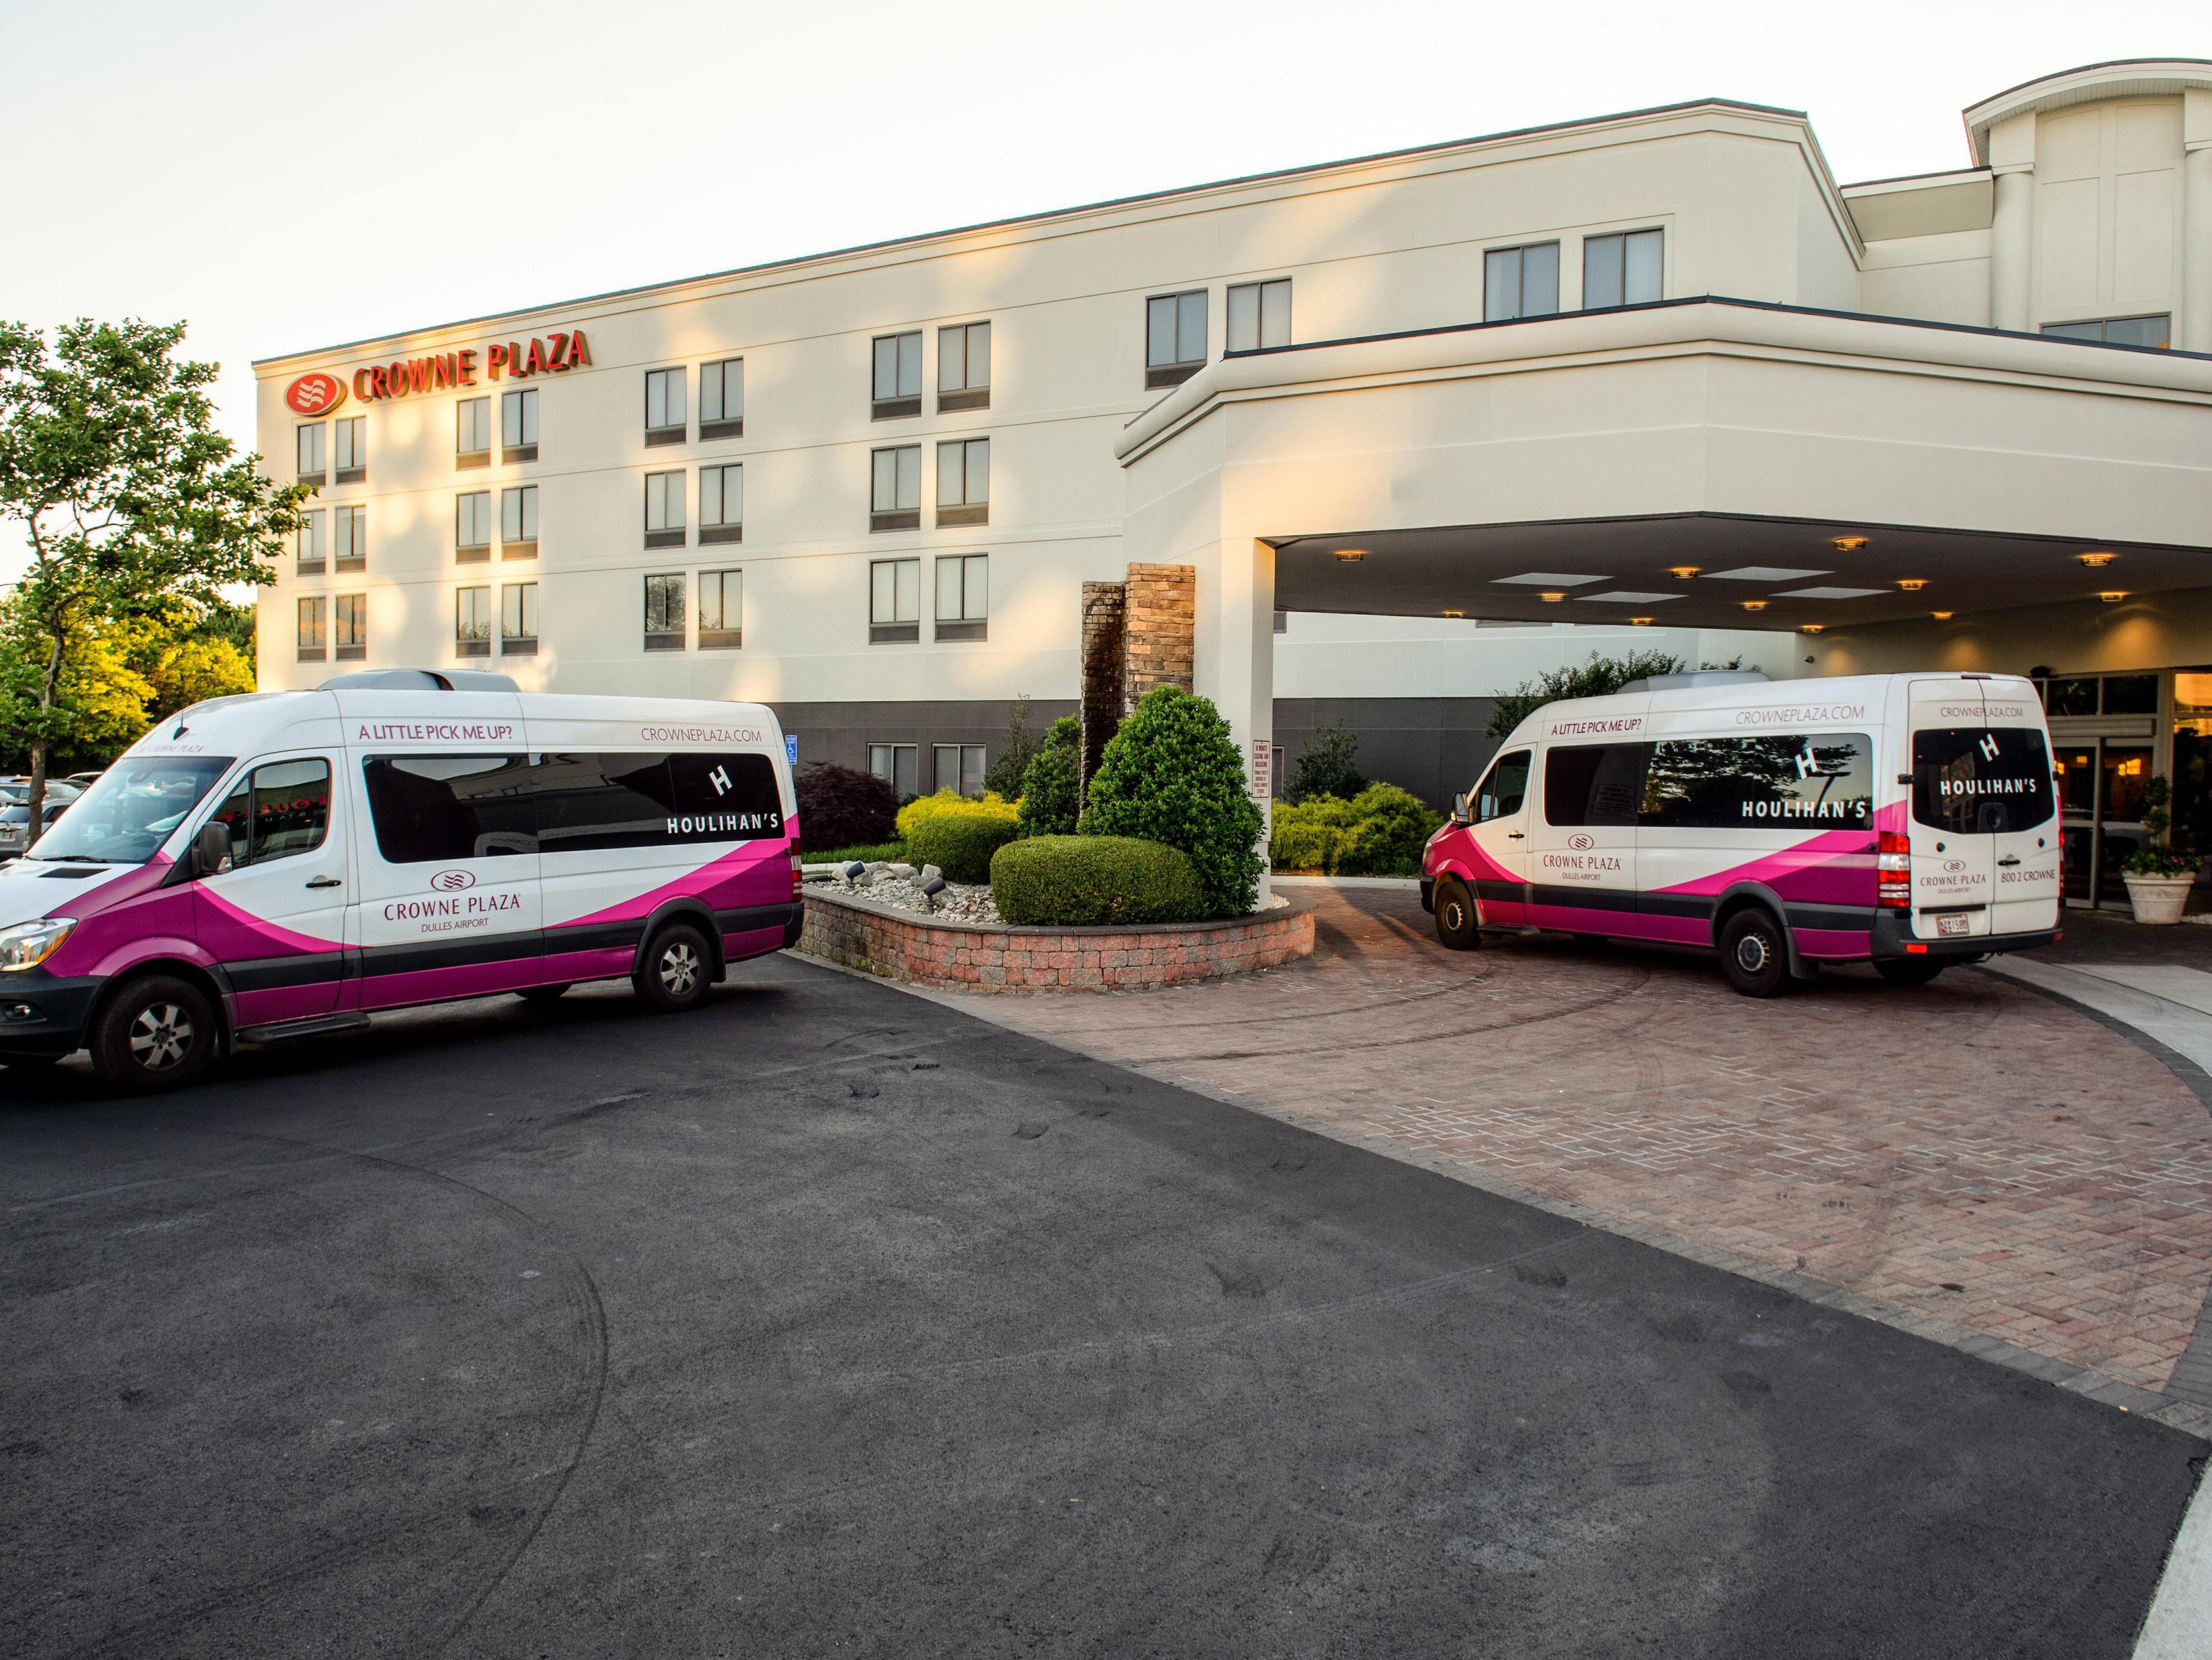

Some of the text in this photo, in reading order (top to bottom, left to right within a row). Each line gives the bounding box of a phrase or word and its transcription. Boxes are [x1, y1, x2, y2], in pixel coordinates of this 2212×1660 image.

[352, 330, 591, 403] CROWNE PLAZA
[1736, 705, 1864, 724] CROWNEPLAZA.COM
[1940, 707, 2023, 717] CROWNEPLAZA.COM
[359, 725, 512, 739] A LITTLE PICK ME UP?
[641, 728, 762, 742] CROWNEPLAZA.COM
[1551, 719, 1641, 735] A LITTLE PICK ME UP?
[1979, 733, 2000, 762] H
[1794, 747, 1818, 780] H
[709, 765, 733, 796] H
[1940, 778, 2036, 795] HOULIHAN'S
[1743, 801, 1866, 818] HOULIHAN'S
[667, 813, 778, 834] HOULIHAN'S
[1543, 855, 1620, 870] CROWNE PLAZA
[1921, 875, 1986, 887] CROWNE PLAZA
[2001, 870, 2056, 883] 800 2 CROWNE
[384, 893, 520, 920] CROWNE PLAZA
[421, 918, 489, 932] DULLES AIRPORT
